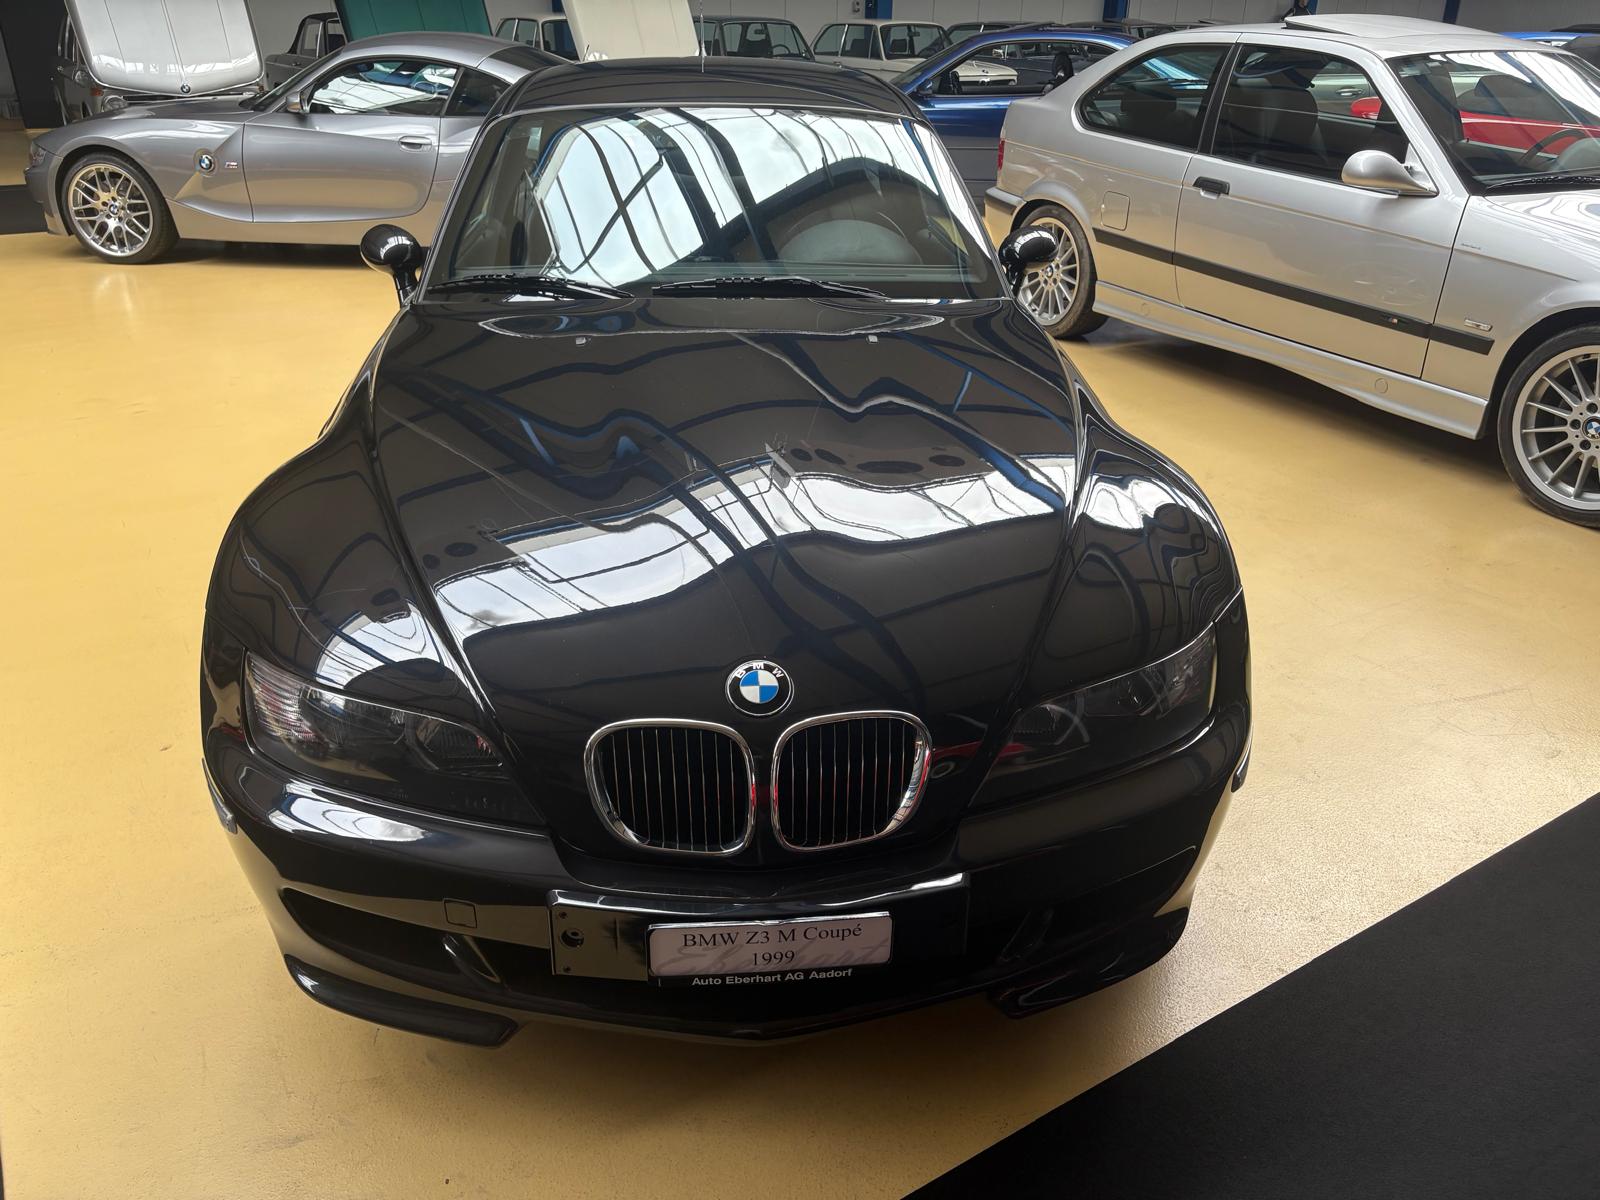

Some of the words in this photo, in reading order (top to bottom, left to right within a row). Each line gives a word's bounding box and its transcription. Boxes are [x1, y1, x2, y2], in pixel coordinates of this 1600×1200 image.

[735, 662, 784, 678] BMW
[682, 931, 740, 947] BMW
[746, 930, 770, 945] Z3
[778, 928, 797, 942] M
[803, 923, 863, 941] Coupé
[753, 950, 795, 966] 1999
[691, 977, 722, 986] Auto
[725, 974, 782, 985] Eberhart
[785, 971, 805, 981] AG
[808, 968, 853, 980] Aadorf
